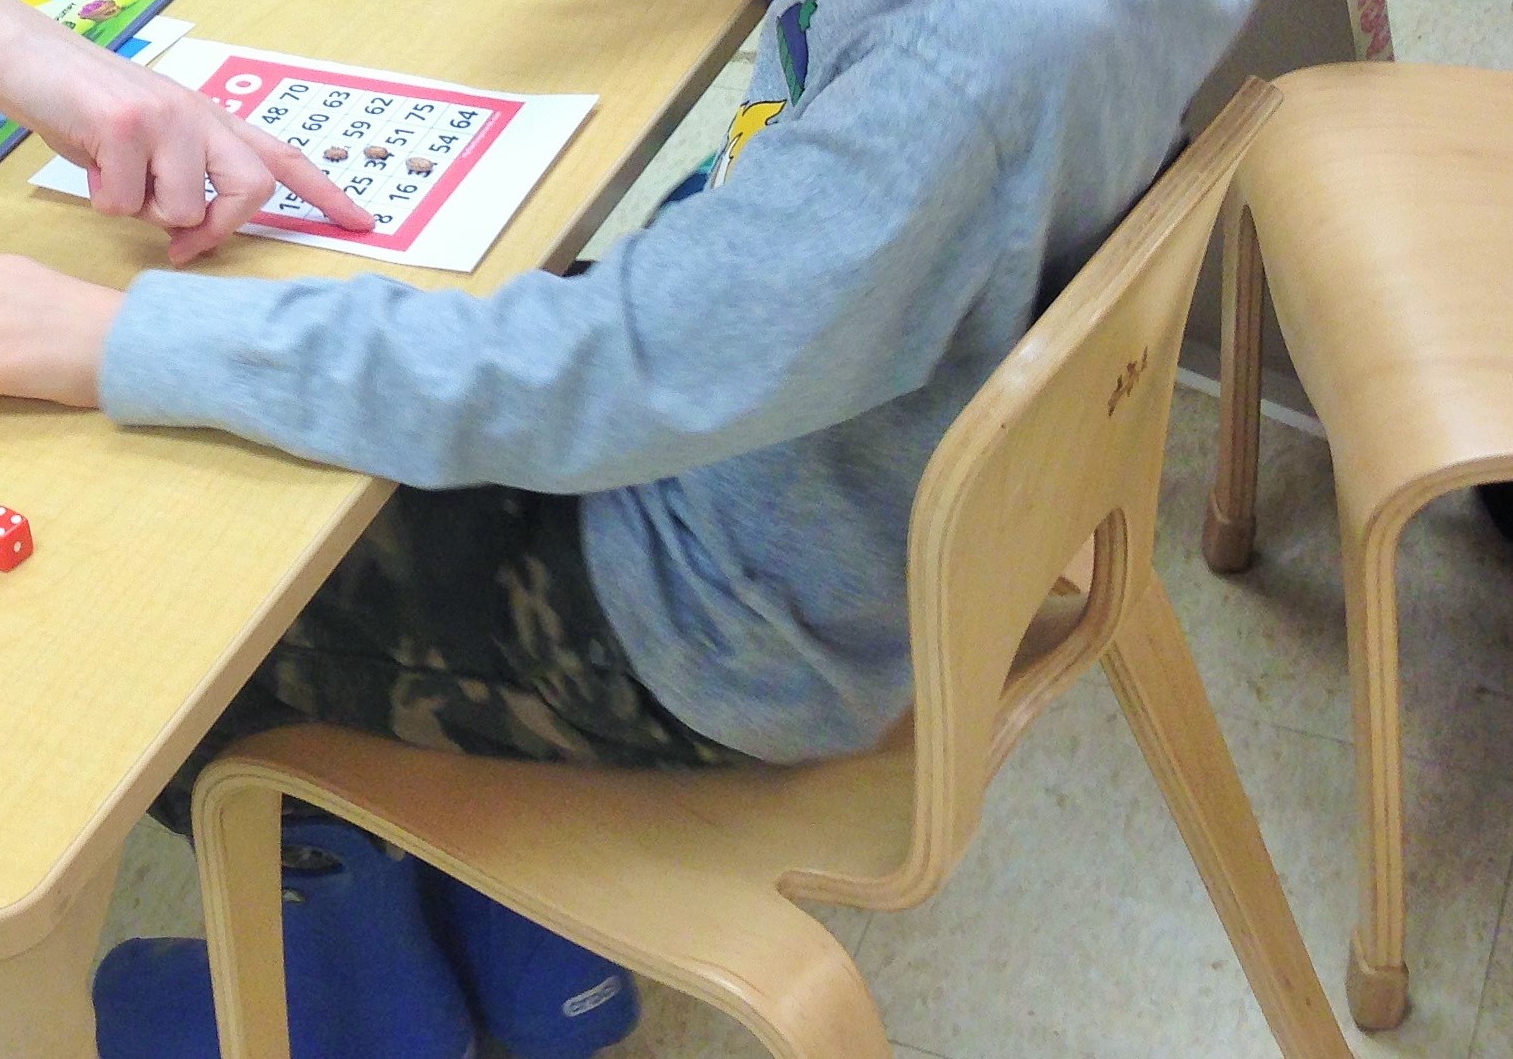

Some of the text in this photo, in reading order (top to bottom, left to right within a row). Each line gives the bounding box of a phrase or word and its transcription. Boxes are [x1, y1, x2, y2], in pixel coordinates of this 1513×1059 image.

[261, 84, 310, 124] 48 70
[301, 113, 330, 131] 60
[322, 90, 351, 108] 63
[342, 120, 372, 139] 59
[364, 97, 394, 115] 62
[343, 176, 374, 195] 25
[385, 128, 415, 147] 51
[404, 103, 435, 121] 75
[388, 183, 418, 201] 16
[428, 134, 459, 154] 54
[449, 110, 479, 129] 64
